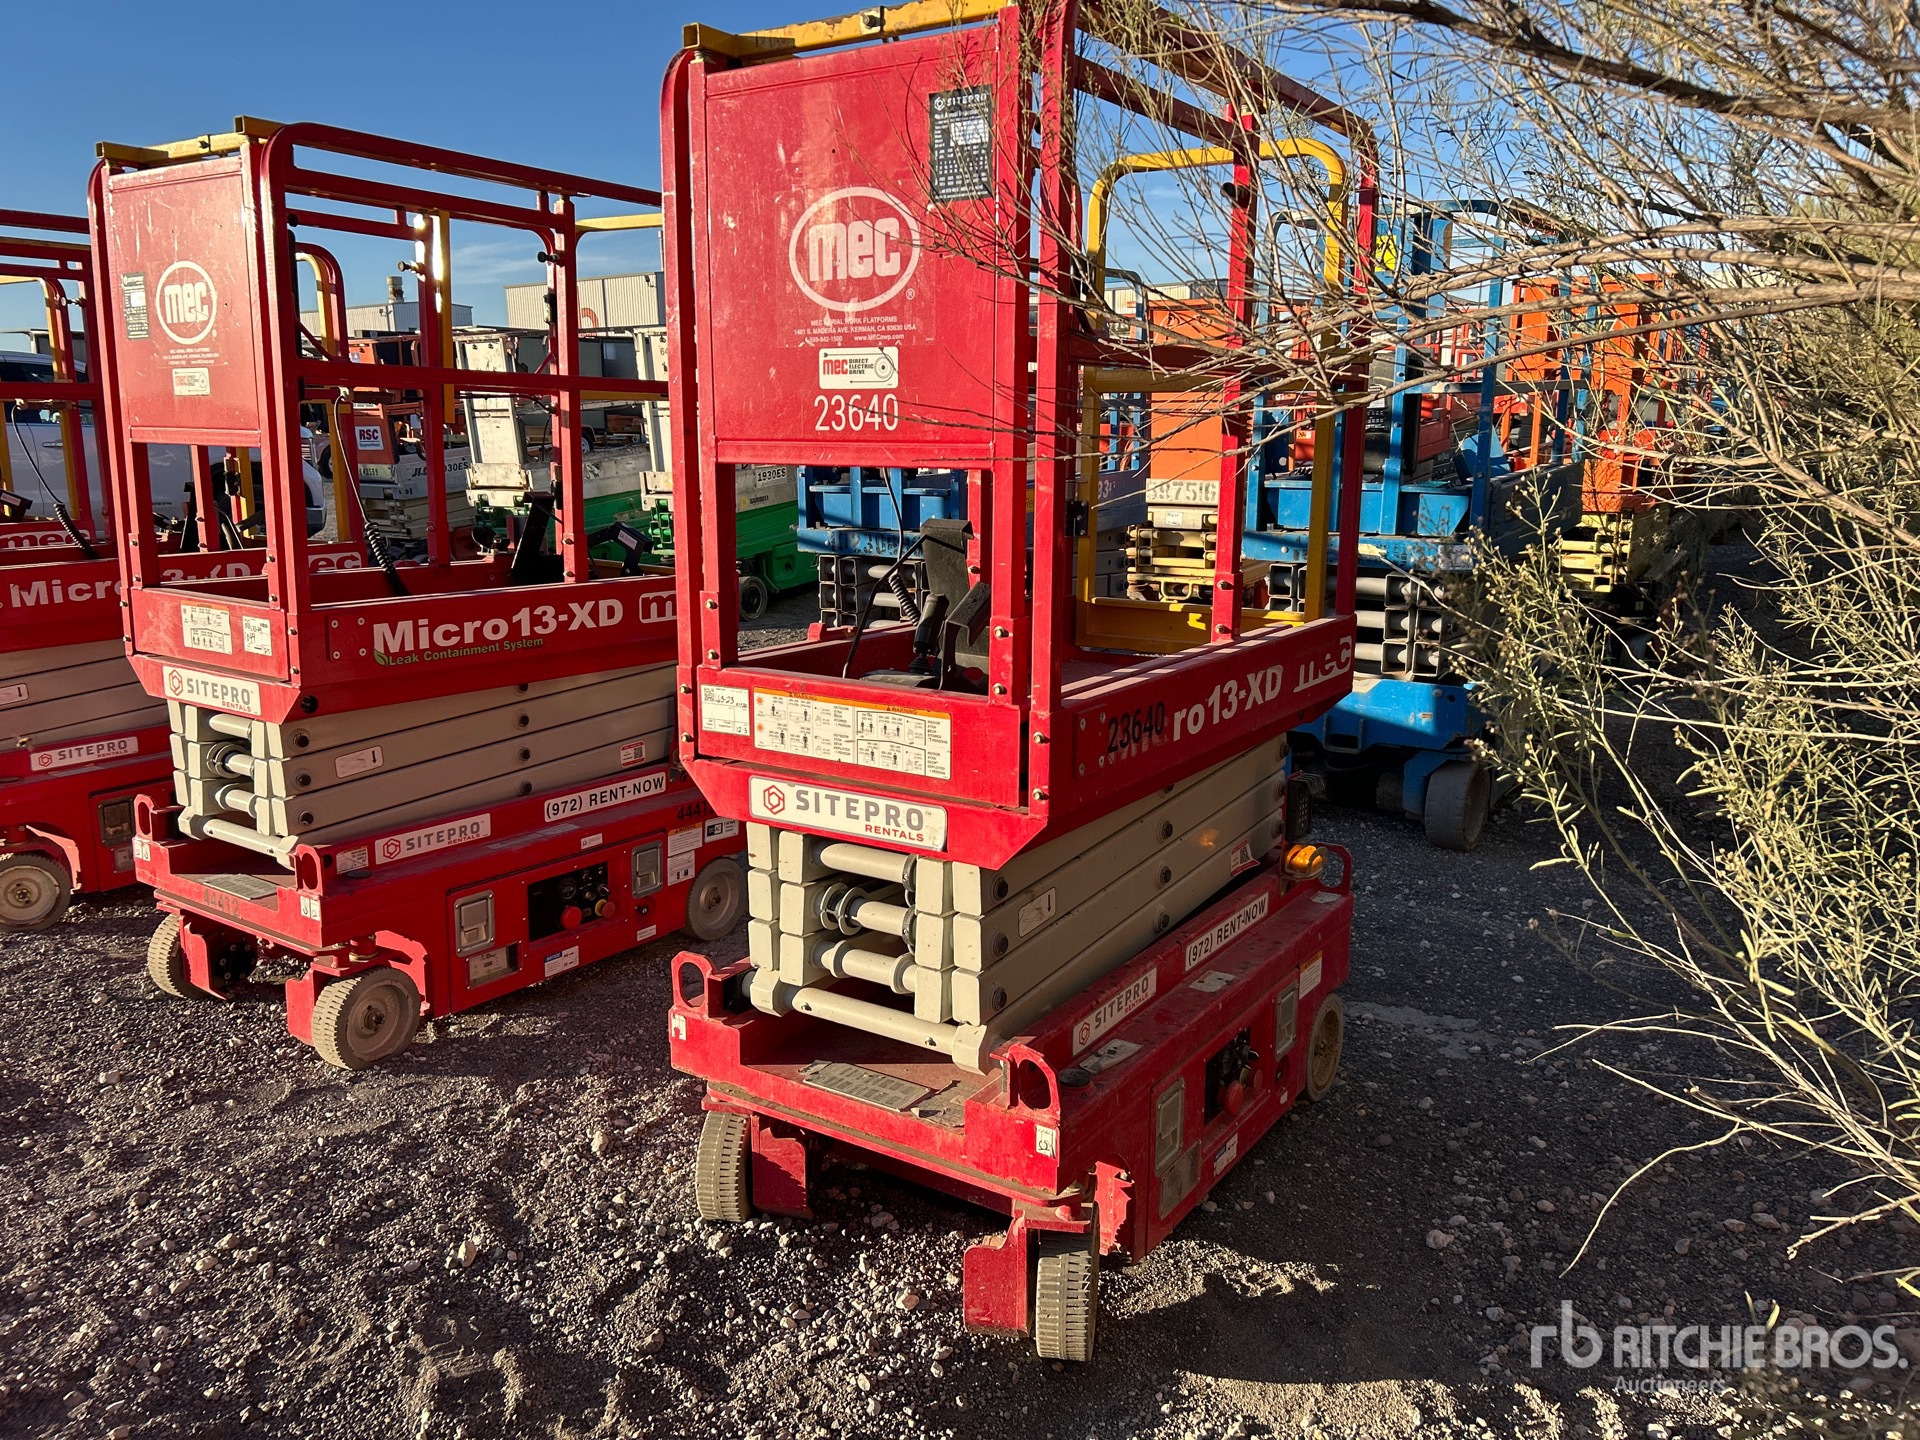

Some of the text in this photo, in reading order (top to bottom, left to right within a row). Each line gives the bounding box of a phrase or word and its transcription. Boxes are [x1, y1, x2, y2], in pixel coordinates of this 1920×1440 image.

[809, 217, 900, 281] mec
[164, 282, 209, 324] mec
[814, 393, 899, 431] 23640
[359, 429, 379, 440] RSC
[757, 467, 786, 482] 1930ES
[388, 637, 544, 667] Leak Containment System
[186, 677, 250, 705] SITEPRO
[222, 700, 251, 713] RENTALS
[1107, 700, 1166, 754] 23640
[58, 740, 127, 761] SITEPRO
[546, 776, 665, 820] (972) RENT-NOW
[677, 800, 714, 820] 4441
[795, 789, 924, 832] SITEPRO
[406, 821, 481, 852] SITEPRO
[447, 833, 481, 846] RENTALS
[865, 824, 924, 843] RENTALS
[1188, 897, 1267, 967] (972) RENT-NOW
[1094, 976, 1149, 1030] SITEPRO
[1124, 992, 1149, 1014] RENTALS
